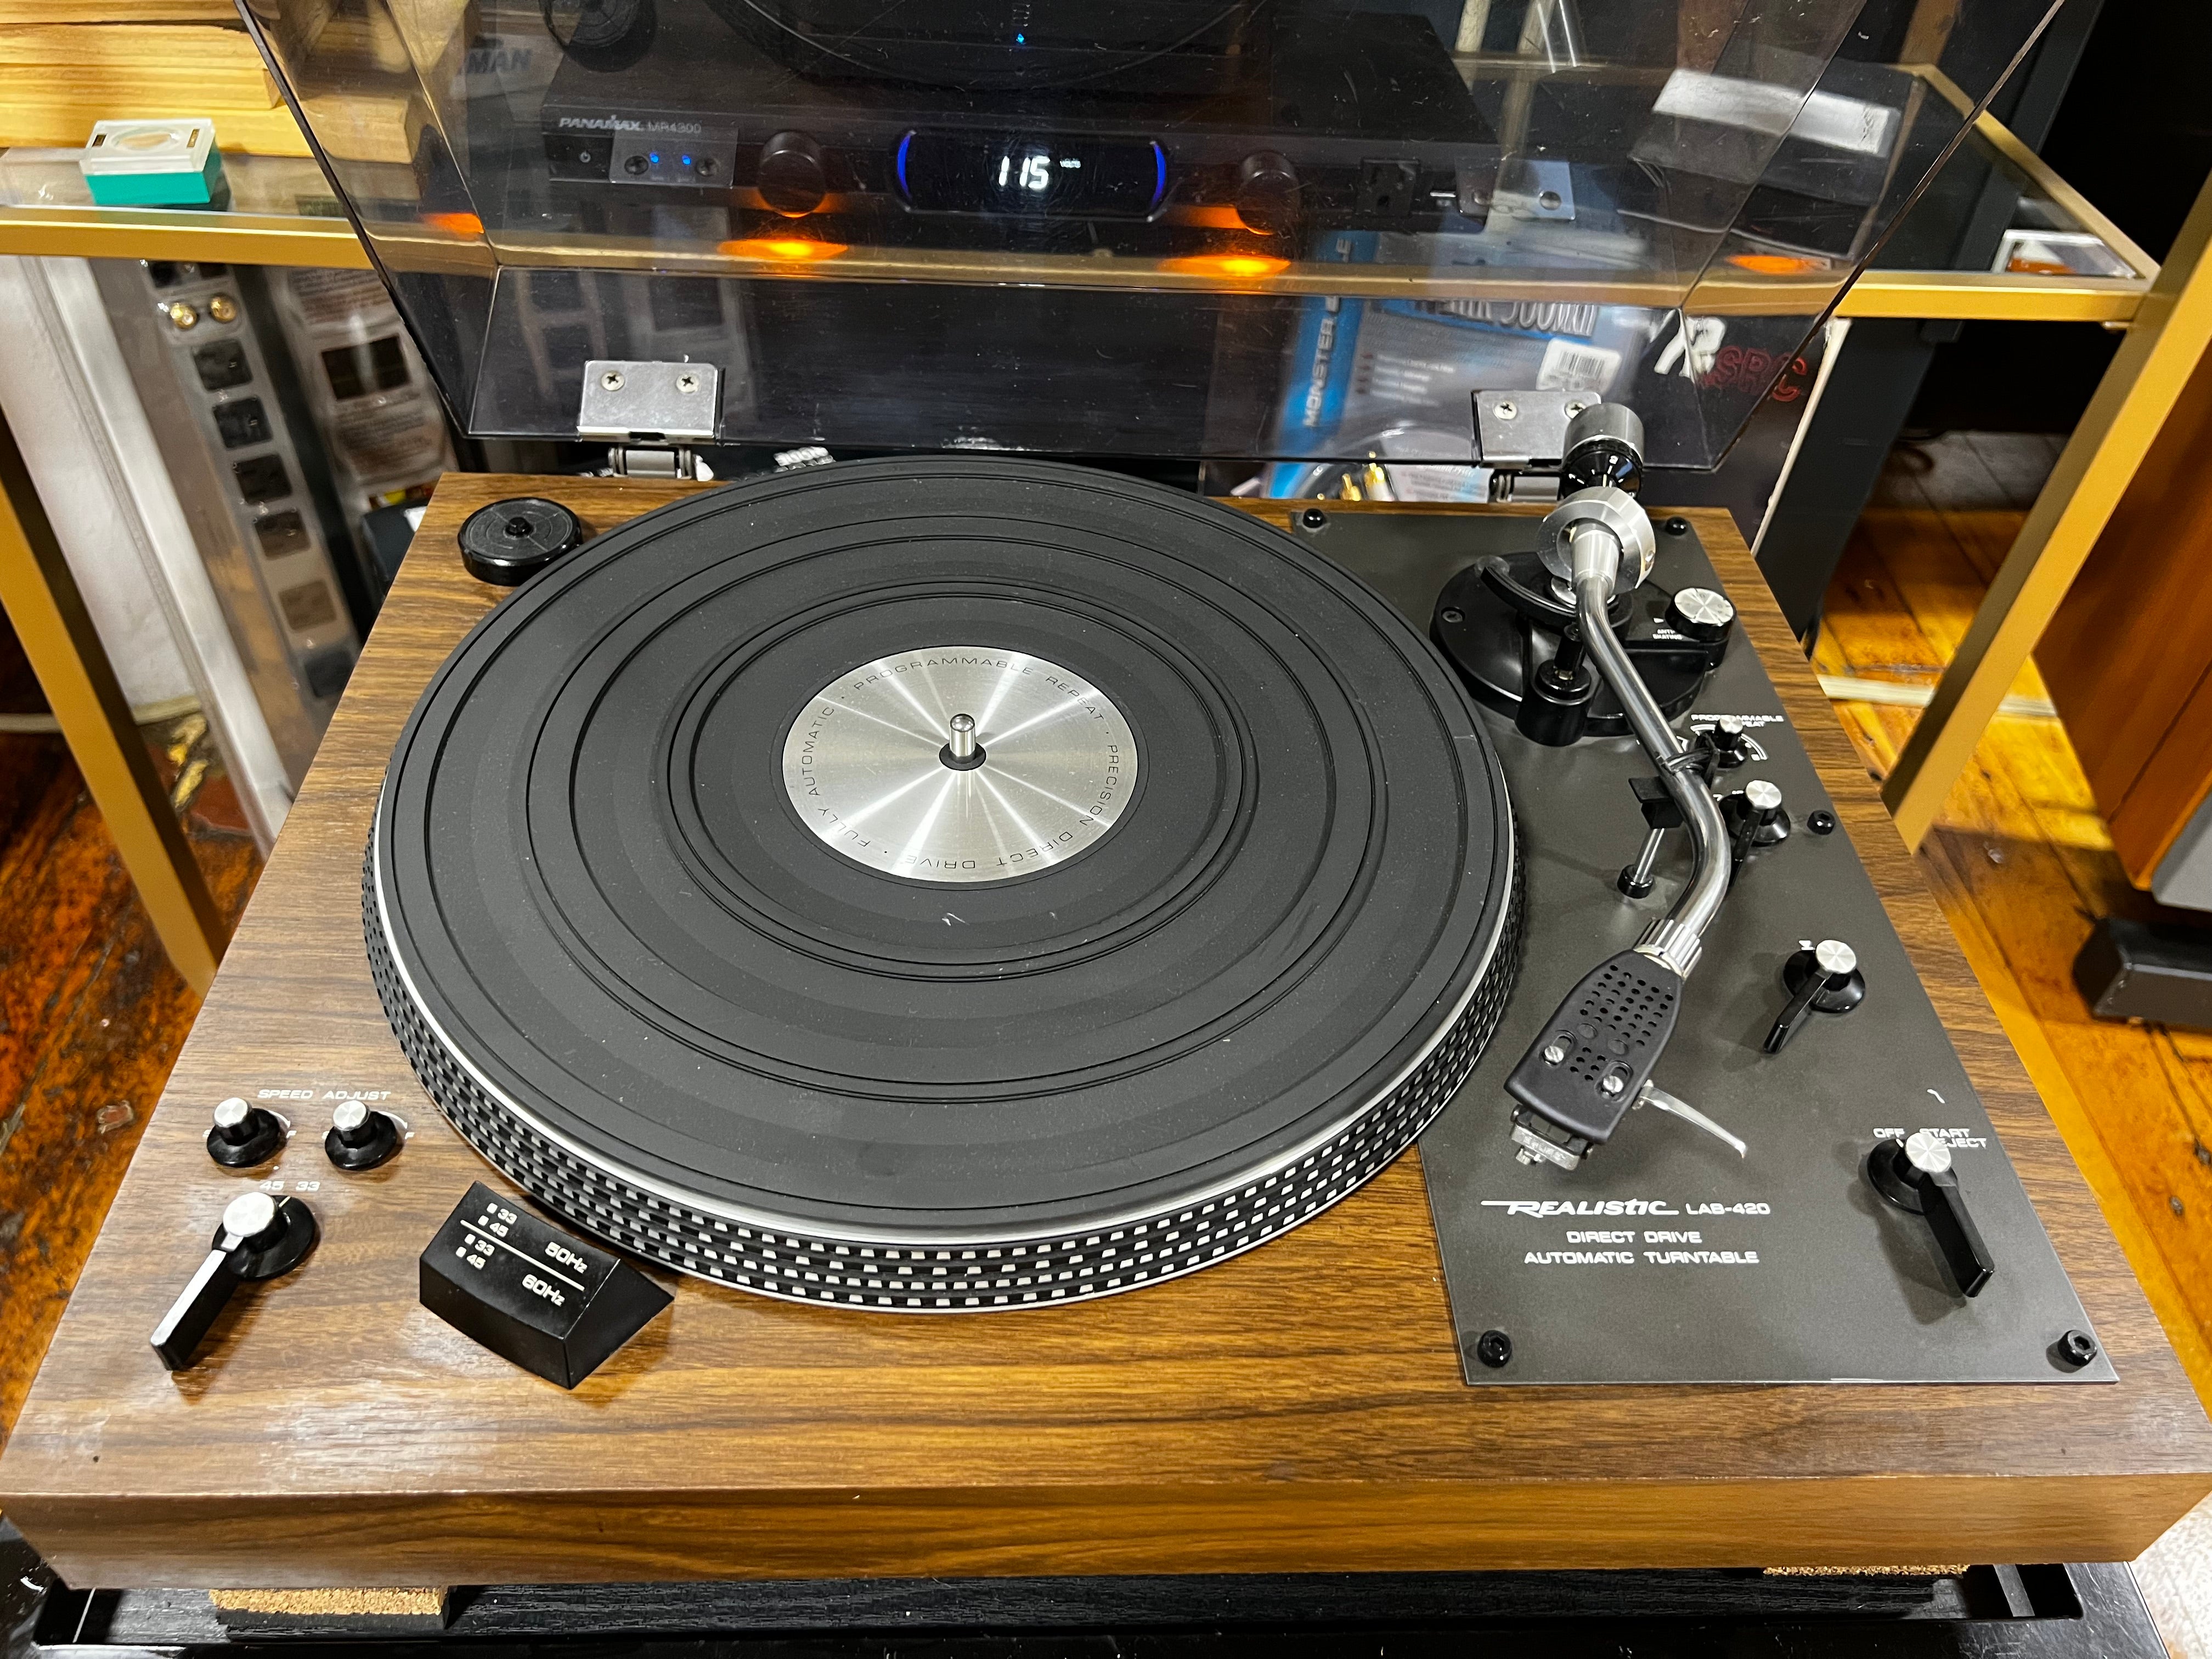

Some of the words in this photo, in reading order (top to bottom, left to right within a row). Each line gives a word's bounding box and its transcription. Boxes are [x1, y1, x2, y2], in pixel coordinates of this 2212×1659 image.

[558, 117, 644, 132] PANAMAX
[998, 155, 1051, 189] 115
[1302, 318, 1335, 428] MONSTER
[854, 657, 1034, 691] PROGRAMMABLE
[1045, 676, 1104, 720] REPEAT
[802, 707, 834, 796] AUTOMATIC
[1079, 744, 1119, 826] PRECISION
[817, 808, 871, 847] FULLY
[996, 831, 1073, 867] DIRECT
[905, 855, 975, 869] DRIVE
[257, 1089, 314, 1099] SPEED
[321, 1090, 392, 1101] ADJUST
[1873, 1128, 1905, 1138] OFF
[259, 1181, 285, 1191] 45
[295, 1181, 321, 1192] 33
[497, 1208, 517, 1224] 33
[1685, 1203, 1771, 1215] LAB-420
[489, 1222, 509, 1238] 45
[1566, 1231, 1635, 1244] DIRECT
[1644, 1231, 1702, 1244] DRIVE
[474, 1239, 495, 1256] 33
[466, 1254, 487, 1270] 45
[544, 1242, 588, 1274] 50Hz
[1524, 1251, 1635, 1264] AUTOMATIC
[1643, 1251, 1760, 1264] TURNTABLE
[522, 1273, 566, 1307] 60Hz
